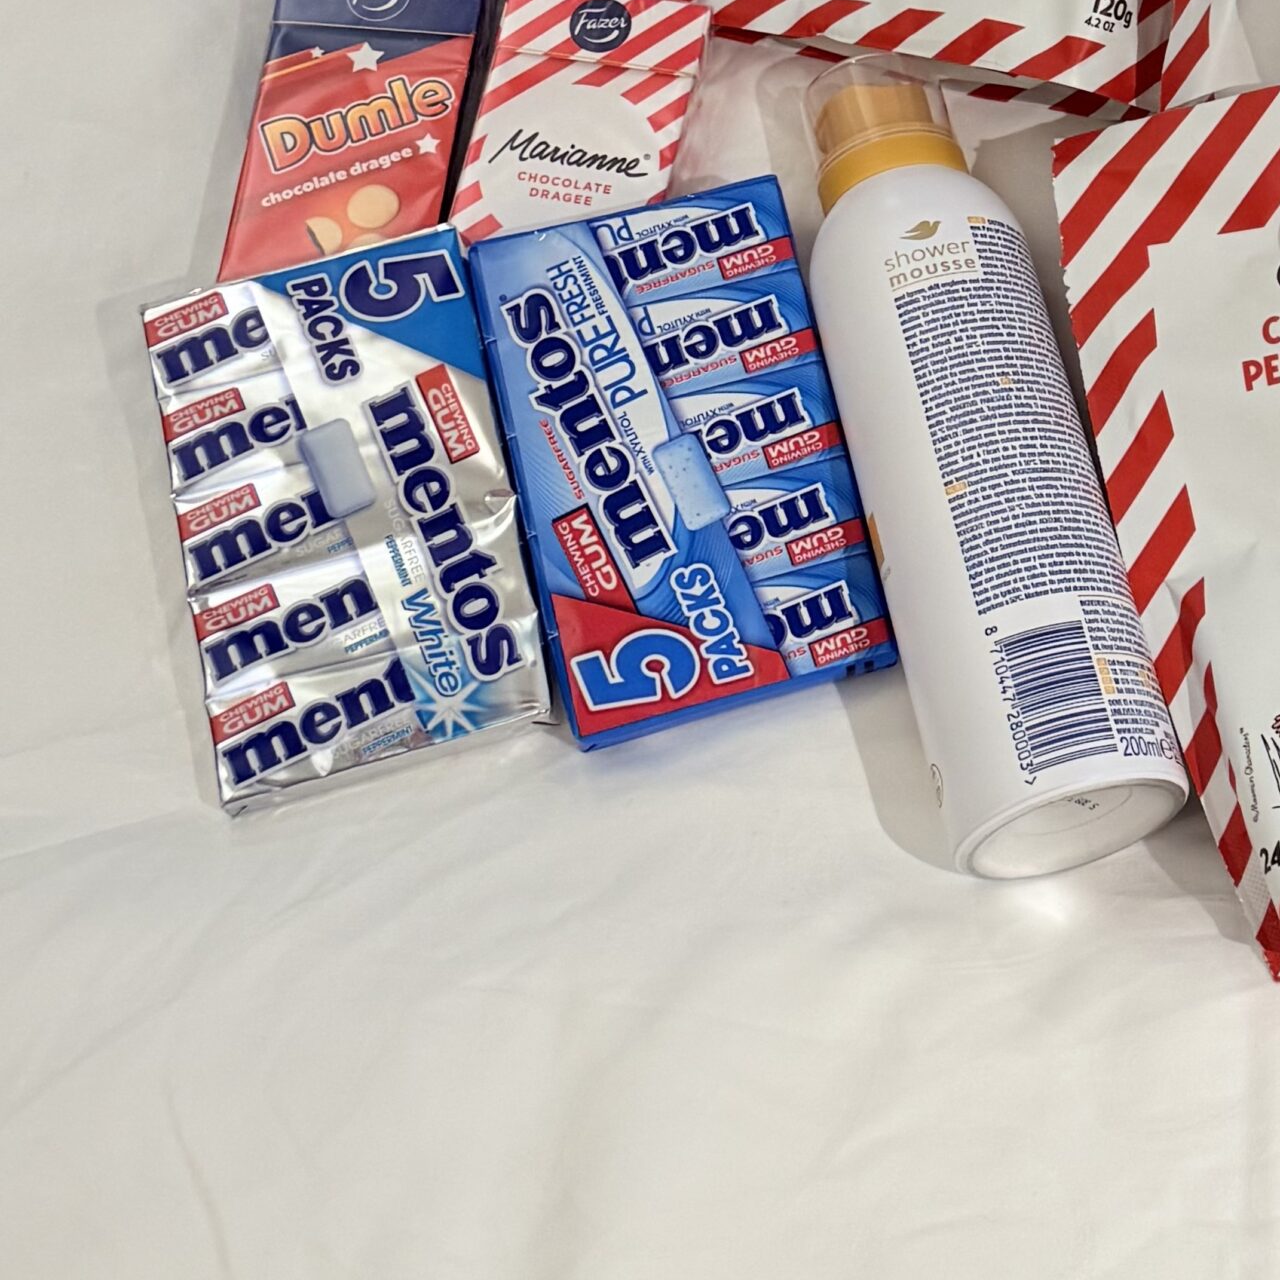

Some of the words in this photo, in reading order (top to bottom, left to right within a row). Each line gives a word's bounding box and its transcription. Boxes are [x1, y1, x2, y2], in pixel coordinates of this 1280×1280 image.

[576, 12, 628, 34] Fazer
[1084, 16, 1101, 28] 4.2
[1103, 21, 1115, 32] OZ
[260, 77, 455, 174] Dumle
[261, 165, 348, 208] chocolate
[349, 145, 413, 177] dragee
[517, 171, 613, 196] CHOCOLATE
[529, 187, 592, 207] DRAGEE
[636, 221, 673, 239] XYLITOL
[722, 245, 774, 269] GUM
[726, 255, 776, 277] CHEWING
[884, 240, 970, 272] shower
[889, 258, 977, 288] mousse
[342, 251, 463, 319] 5
[546, 259, 596, 327] FRESH
[570, 255, 608, 316] FRESHMINT
[635, 261, 715, 294] SUGARFREE
[154, 296, 219, 327] CHEWING
[157, 305, 222, 337] GUM
[657, 313, 695, 332] XYLITOL
[290, 277, 361, 382] PACKS
[576, 316, 648, 409] PURE
[744, 337, 798, 362] GUM
[748, 346, 799, 371] CHEWING
[170, 392, 235, 421] CHEWING
[173, 399, 239, 433] GUM
[427, 387, 469, 459] GUM
[440, 383, 476, 452] CHEWING
[616, 411, 647, 457] XYLITOL
[768, 431, 821, 457] GUM
[539, 418, 585, 500] SUGARFREE
[771, 442, 823, 465] CHEWING
[186, 486, 251, 520] CHEWING
[190, 493, 256, 534] GUM
[368, 385, 523, 677] mentos
[791, 527, 844, 553] GUM
[555, 520, 601, 598] CHEWING
[570, 512, 618, 592] GUM
[795, 538, 847, 562] CHEWING
[202, 587, 269, 620] CHEWING
[206, 594, 273, 633] GUM
[206, 579, 377, 681] men
[672, 564, 753, 683] PACKS
[984, 625, 998, 636] 8
[402, 588, 462, 697] White
[814, 628, 868, 654] GUM
[818, 639, 870, 663] CHEWING
[574, 631, 699, 709] 5
[990, 644, 1017, 702] 710447
[219, 686, 285, 722] CHEWING
[223, 694, 290, 734] GUM
[1006, 711, 1034, 772] 280003
